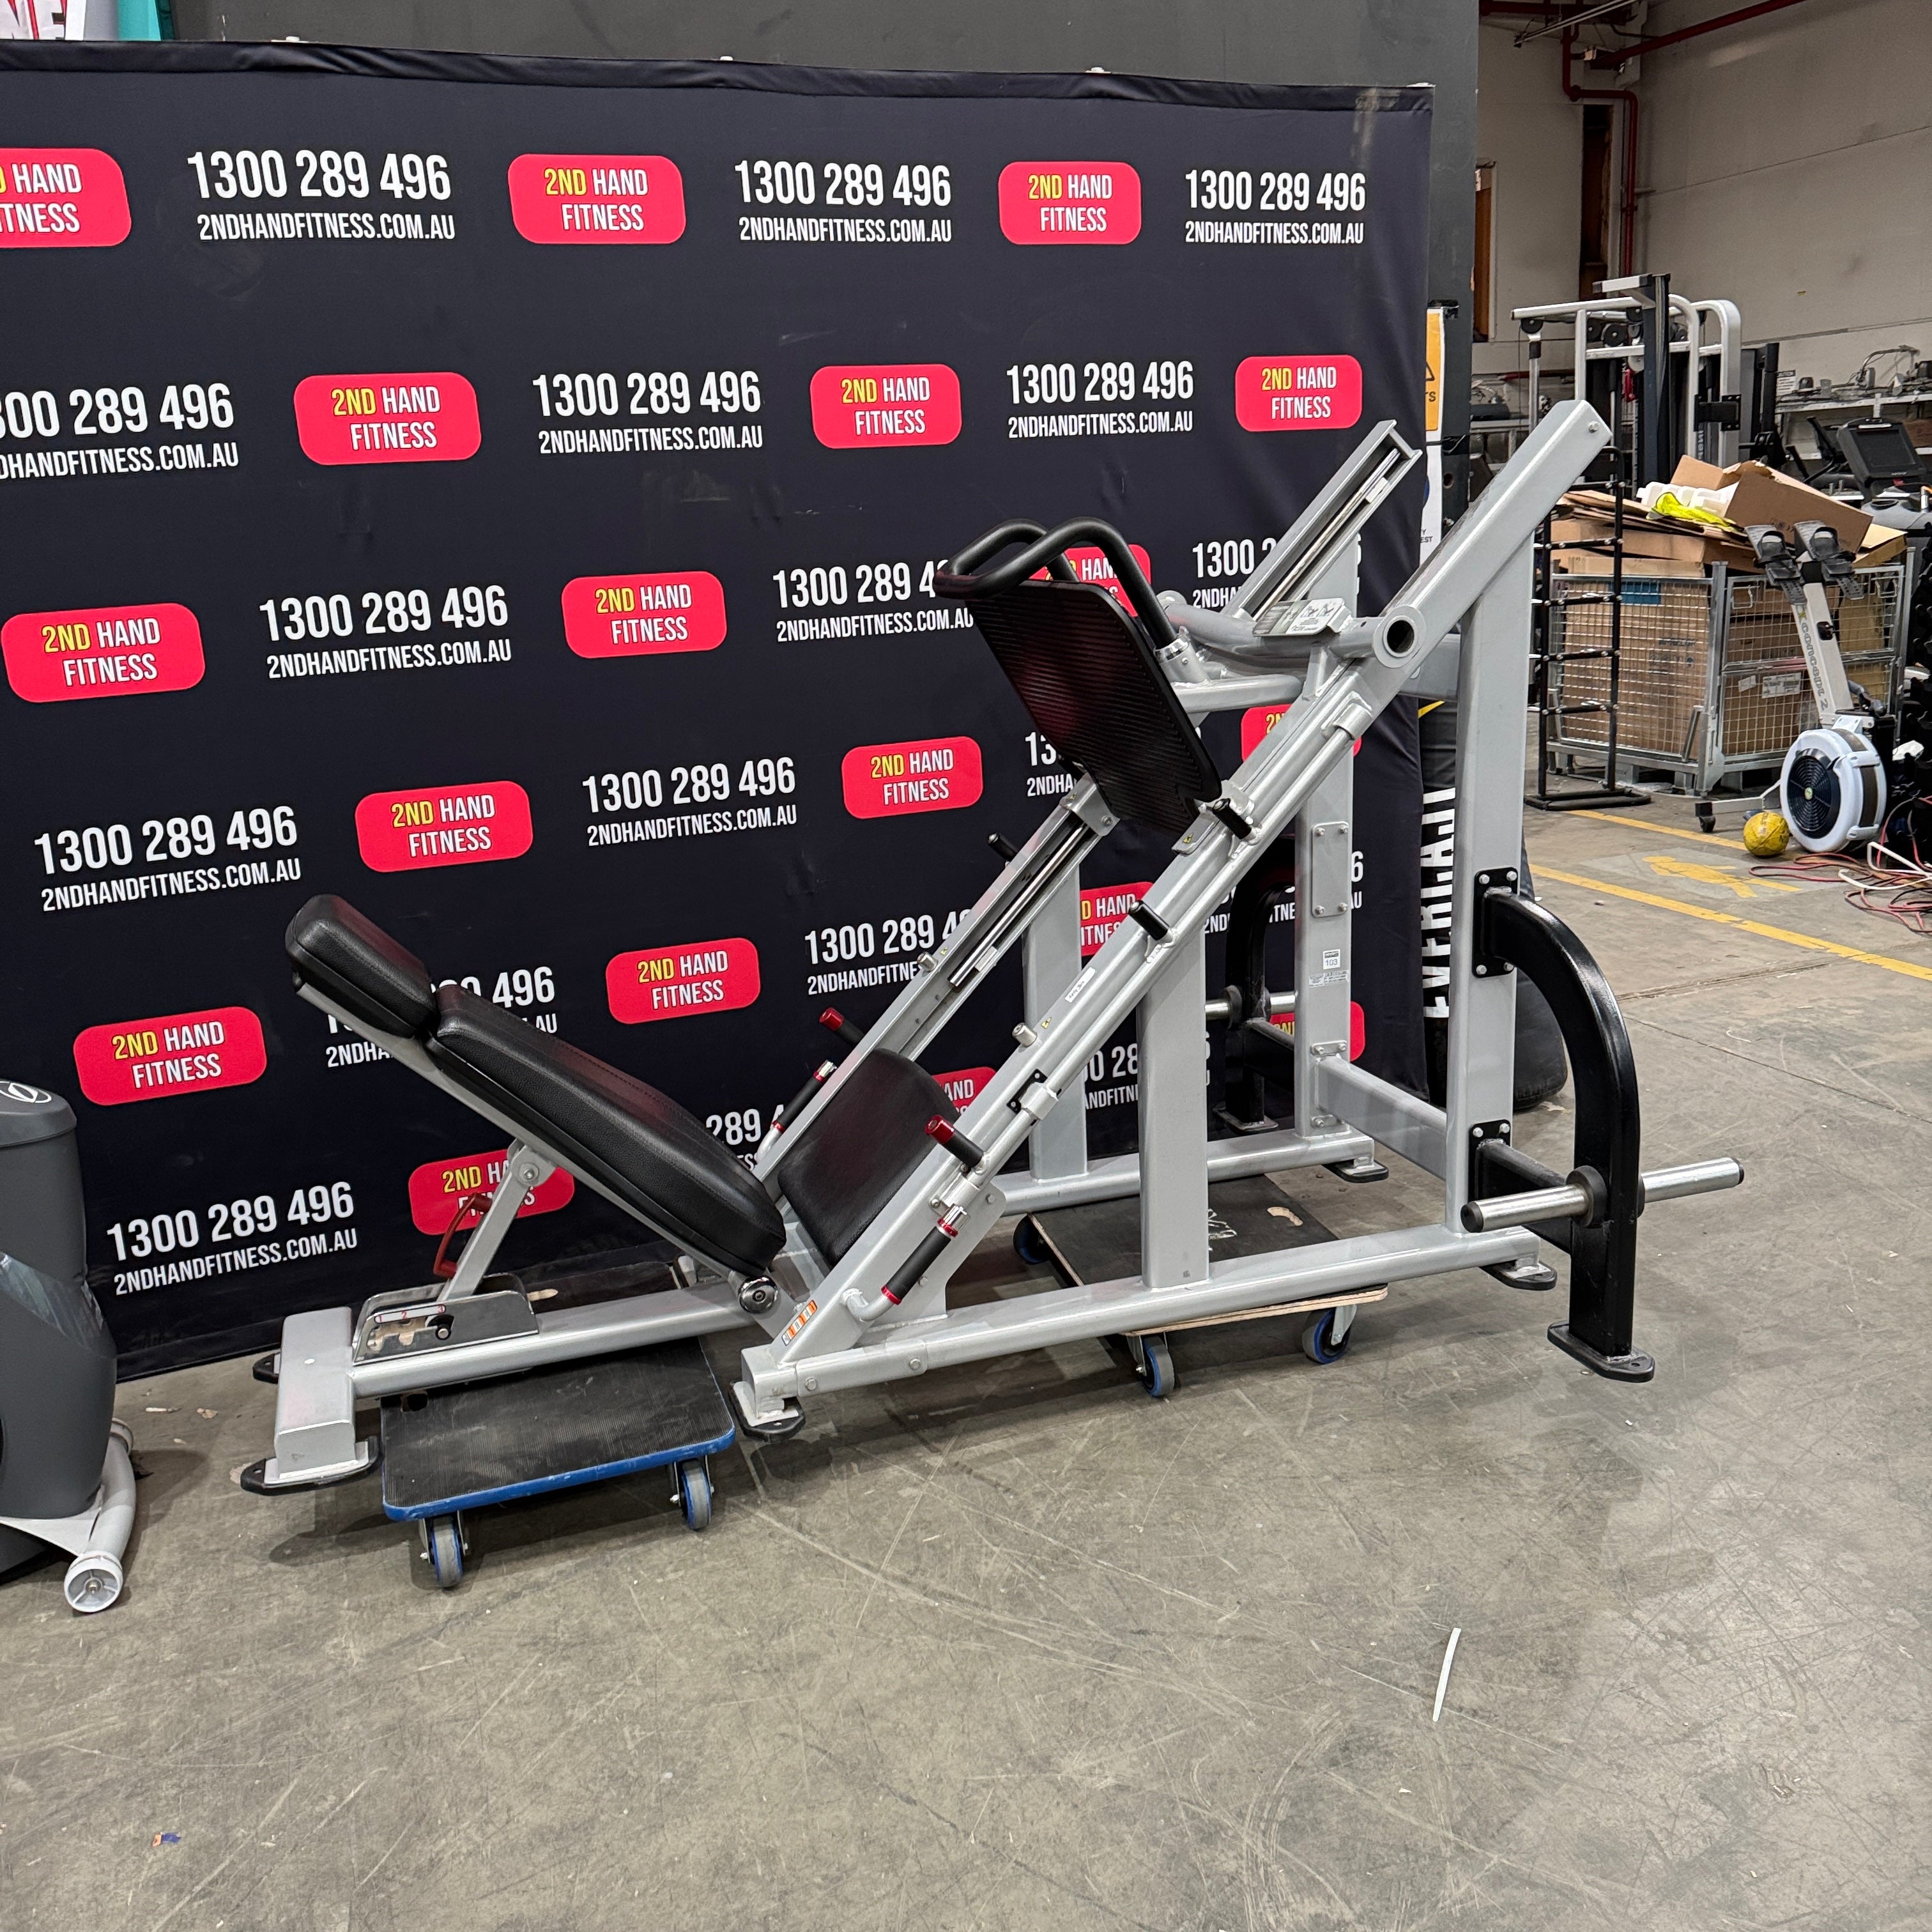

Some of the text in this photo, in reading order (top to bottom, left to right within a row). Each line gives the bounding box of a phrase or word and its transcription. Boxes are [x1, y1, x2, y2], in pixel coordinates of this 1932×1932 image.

[12, 164, 82, 193] HAND
[187, 150, 451, 201] 1300 289 496
[544, 168, 648, 195] 2ND HAND
[734, 160, 951, 206] 1300 289 496
[1028, 174, 1112, 199] 2ND HAND
[1185, 169, 1366, 211] 1300 289 496
[0, 203, 80, 233] TNESS
[197, 212, 456, 240] 2NDHANDFITNESS.COM.AU
[562, 204, 644, 231] FITNESS
[739, 217, 952, 242] 2NDHANDFITNESS.COM.AU
[1040, 206, 1107, 232] FITNESS
[1185, 220, 1364, 244] 2NDHANDFITNESS.COM.AU
[841, 377, 930, 403] 2ND HAND
[1006, 360, 1193, 404] 1300 289 496
[1262, 366, 1337, 390] 2ND HAND
[69, 387, 148, 435] 289
[159, 383, 234, 430] 496
[332, 386, 440, 416] 2ND HAND
[532, 371, 761, 417] 1300 289 496
[1271, 395, 1331, 419] FITNESS
[350, 421, 437, 450] FITNESS
[855, 409, 926, 435] FITNESS
[1008, 410, 1193, 438] 2NDHANDFITNESS.COM.AU
[538, 425, 763, 454] 2NDHANDFITNESS.COM.AU
[1081, 556, 1118, 581] HAN
[1192, 540, 1255, 578] 1300
[595, 584, 692, 613] 2ND HAND
[772, 566, 848, 608] 1300
[855, 562, 911, 603] 289
[259, 585, 508, 641] 1300 289 496
[776, 607, 974, 643] 2NDHANDFITNESS.COM.AU
[42, 618, 160, 653] 2ND HAND
[611, 616, 688, 644] FITNESS
[63, 653, 157, 686] FITNESS
[266, 638, 512, 678] 2NDHANDFITNESS.COM.AU
[1820, 698, 1828, 711] 2
[871, 749, 954, 778] 2ND HAND
[1025, 732, 1057, 766] 13
[582, 756, 795, 813] 1300 289 496
[884, 778, 949, 805] FITNESS
[391, 795, 495, 827] 2ND HAND
[587, 804, 797, 847] 2NDHANDFITNESS.COM.AU
[34, 806, 297, 875] 1300 289 496
[409, 826, 491, 857] FITNESS
[41, 857, 301, 912] 2NDHANDFITNESS.COM.AU
[804, 923, 875, 965] 1300
[882, 914, 935, 954] 289
[638, 951, 728, 983] 2ND HAND
[807, 961, 919, 995] 2NDHANDFITNE
[1325, 958, 1338, 967] 103
[492, 966, 555, 1008] 496
[652, 979, 724, 1009] FITNESS
[112, 1021, 224, 1060] 2ND HAND
[132, 1053, 222, 1088] FITNESS
[1111, 1043, 1138, 1078] 28
[944, 1078, 974, 1101] AND
[705, 1108, 762, 1146] 289
[442, 1166, 482, 1193] 2ND
[106, 1181, 354, 1261] 1300 289 496
[114, 1227, 358, 1296] 2NDHANDFITNESS.COM.AU
[401, 1311, 408, 1319] 2
[438, 1305, 444, 1314] 3
